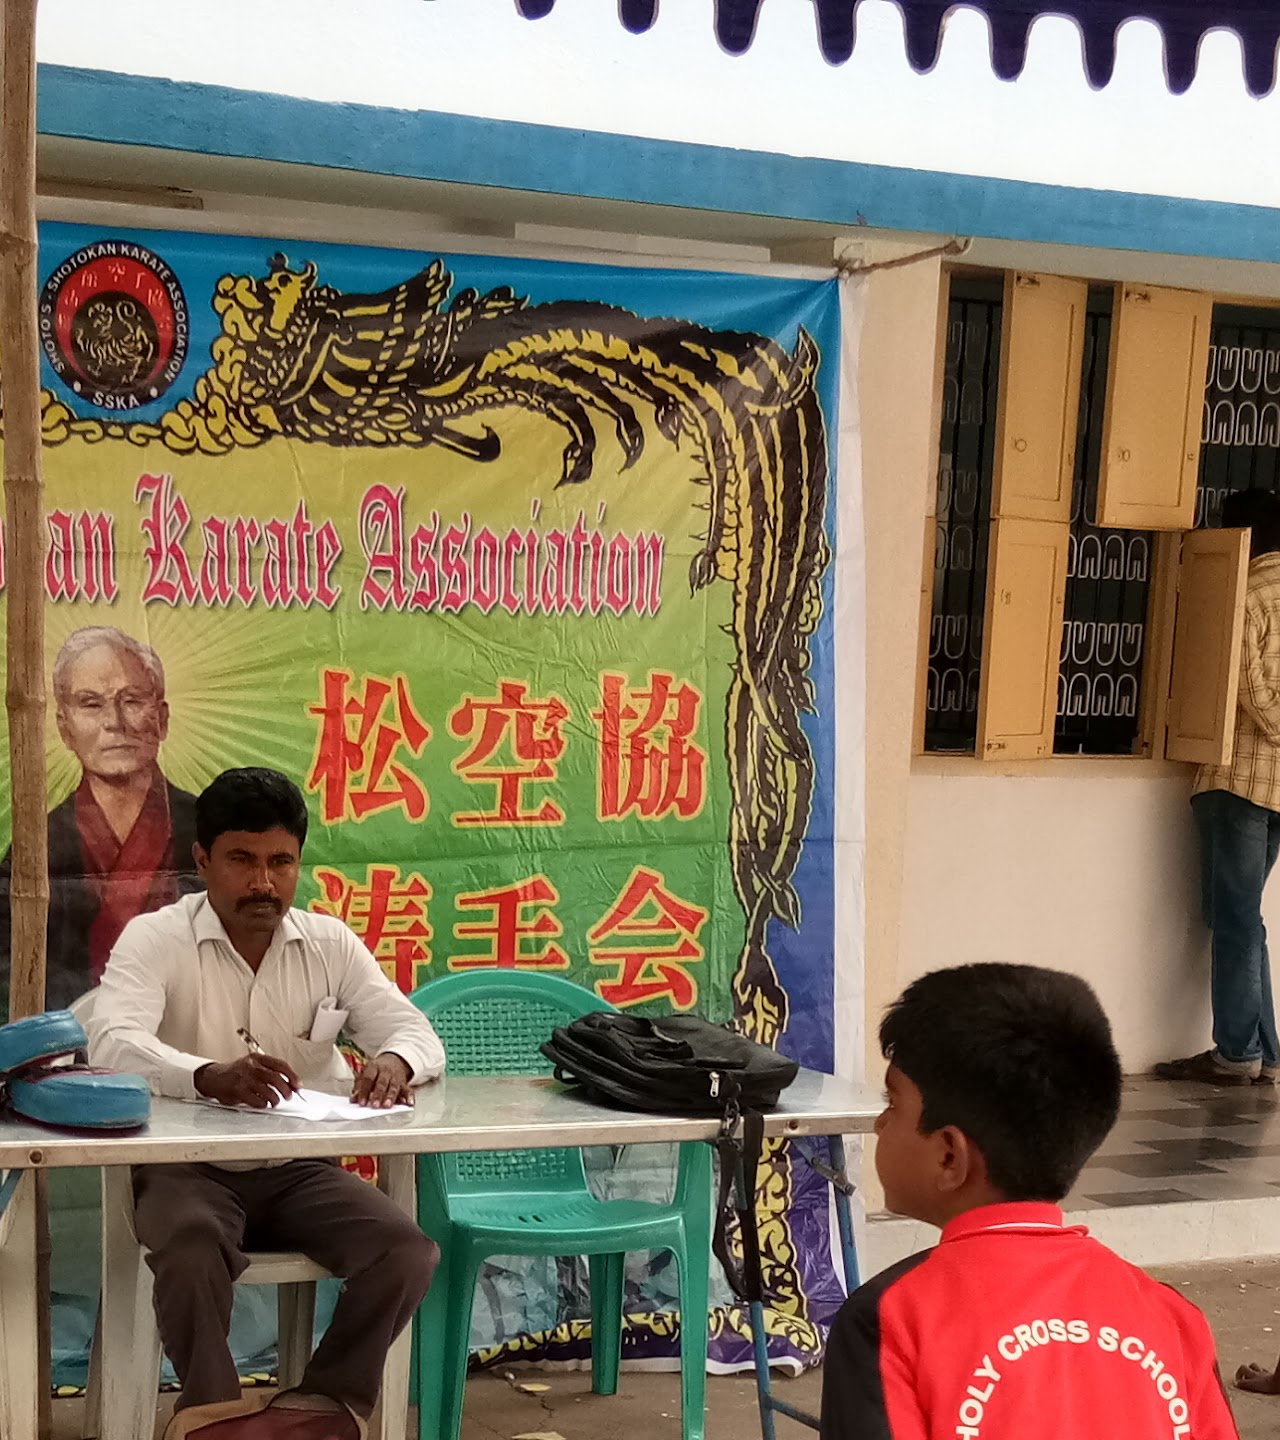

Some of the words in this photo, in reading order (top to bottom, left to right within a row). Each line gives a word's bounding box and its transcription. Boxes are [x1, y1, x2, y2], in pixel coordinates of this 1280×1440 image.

[48, 243, 117, 292] SHOTOKAN
[121, 243, 171, 281] KARATE
[164, 282, 187, 383] ASSOCIATION
[92, 391, 140, 411] SSKA
[134, 472, 341, 611] Karate
[358, 483, 664, 617] Association
[997, 1318, 1090, 1361] CROSS
